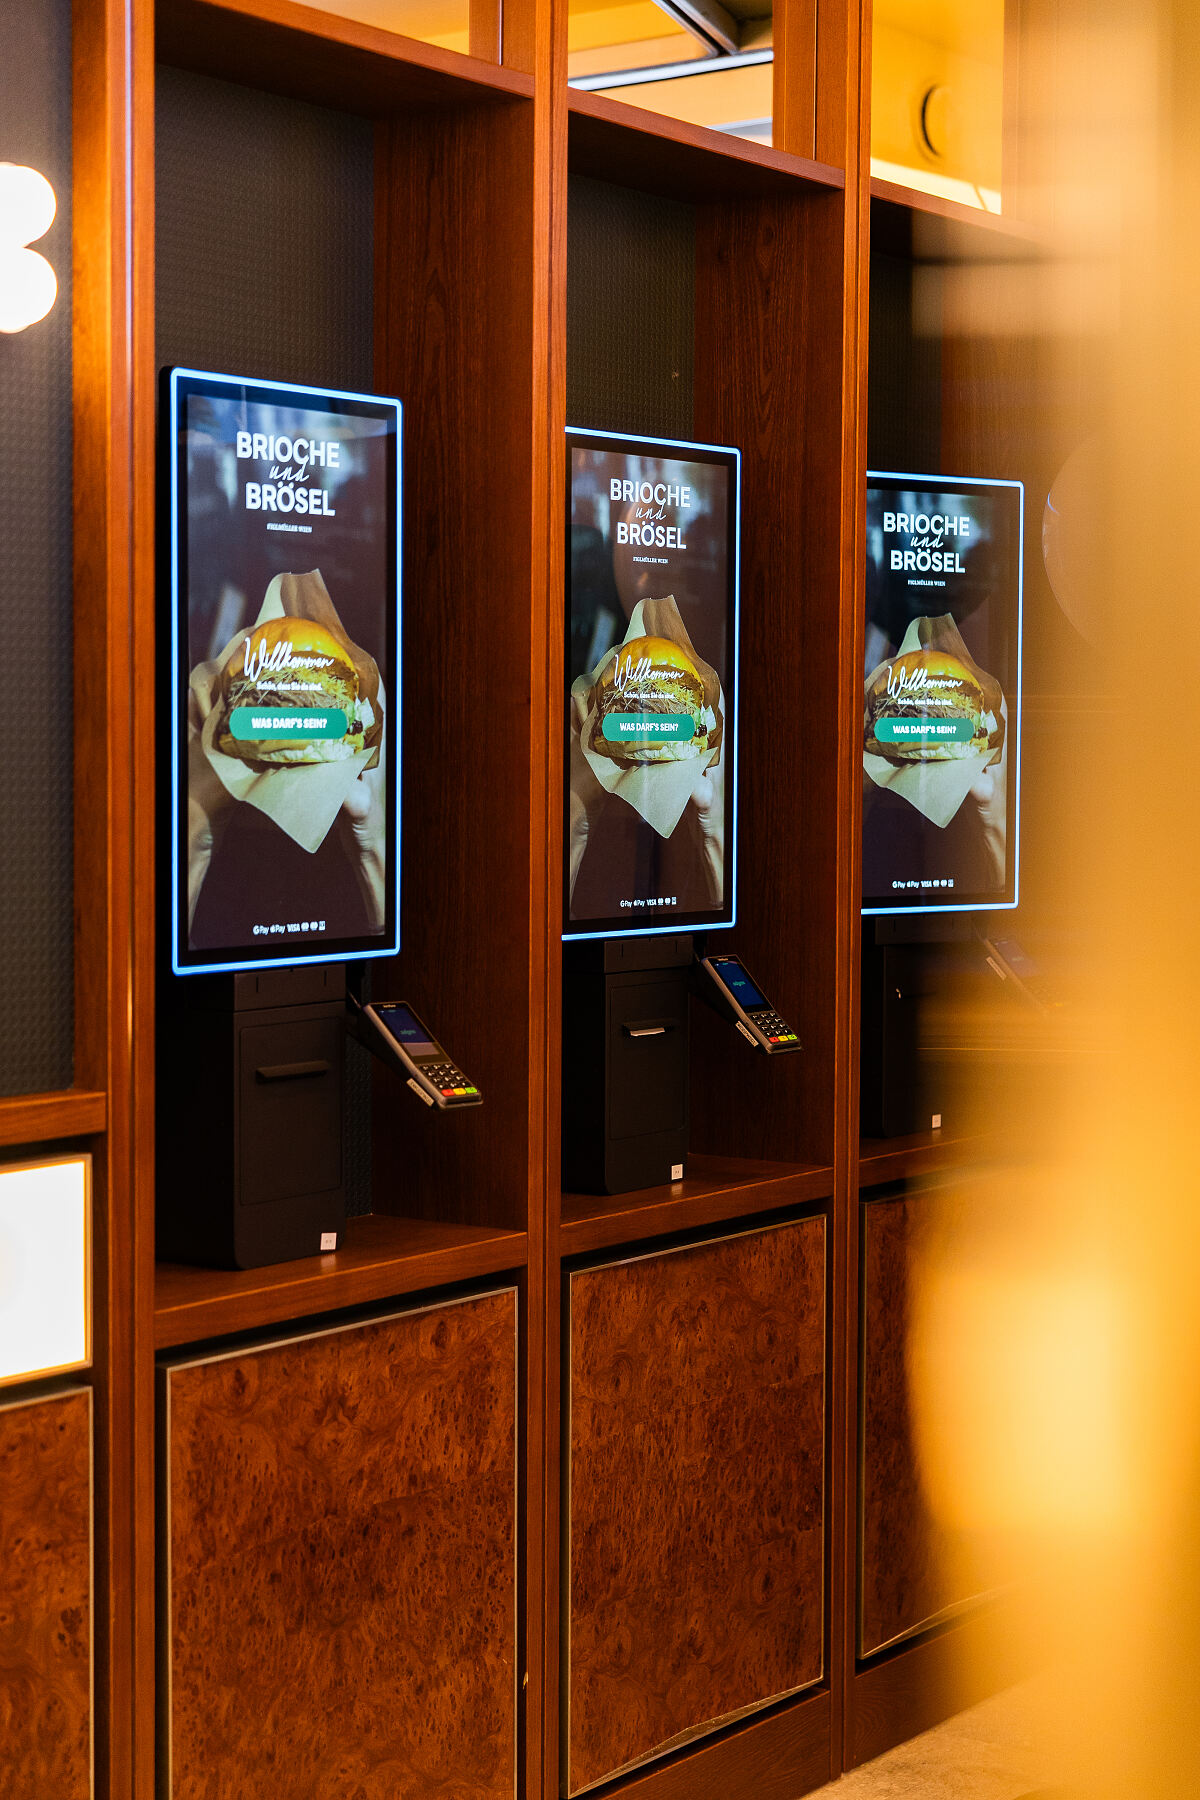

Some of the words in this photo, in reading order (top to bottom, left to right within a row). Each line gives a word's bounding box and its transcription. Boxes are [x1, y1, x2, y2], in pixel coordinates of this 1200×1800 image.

[236, 430, 340, 468] BRIOCHE
[268, 456, 310, 482] und
[245, 481, 336, 516] BRÖSEL
[610, 478, 691, 508] BRIOCHE
[635, 504, 667, 521] und
[883, 511, 970, 537] BRIOCHE
[616, 520, 687, 550] BRÖSEL
[910, 533, 944, 548] und
[890, 548, 966, 574] BRÖSEL
[243, 637, 335, 683] Willkommen
[614, 654, 685, 692] Willkommen
[887, 665, 963, 699] Willkommen
[251, 717, 273, 729] WAS
[303, 717, 328, 729] SEIN?
[619, 722, 636, 732] WAS
[660, 722, 679, 732] SEIN?
[892, 725, 910, 734] WAS
[936, 725, 957, 735] SEIN?
